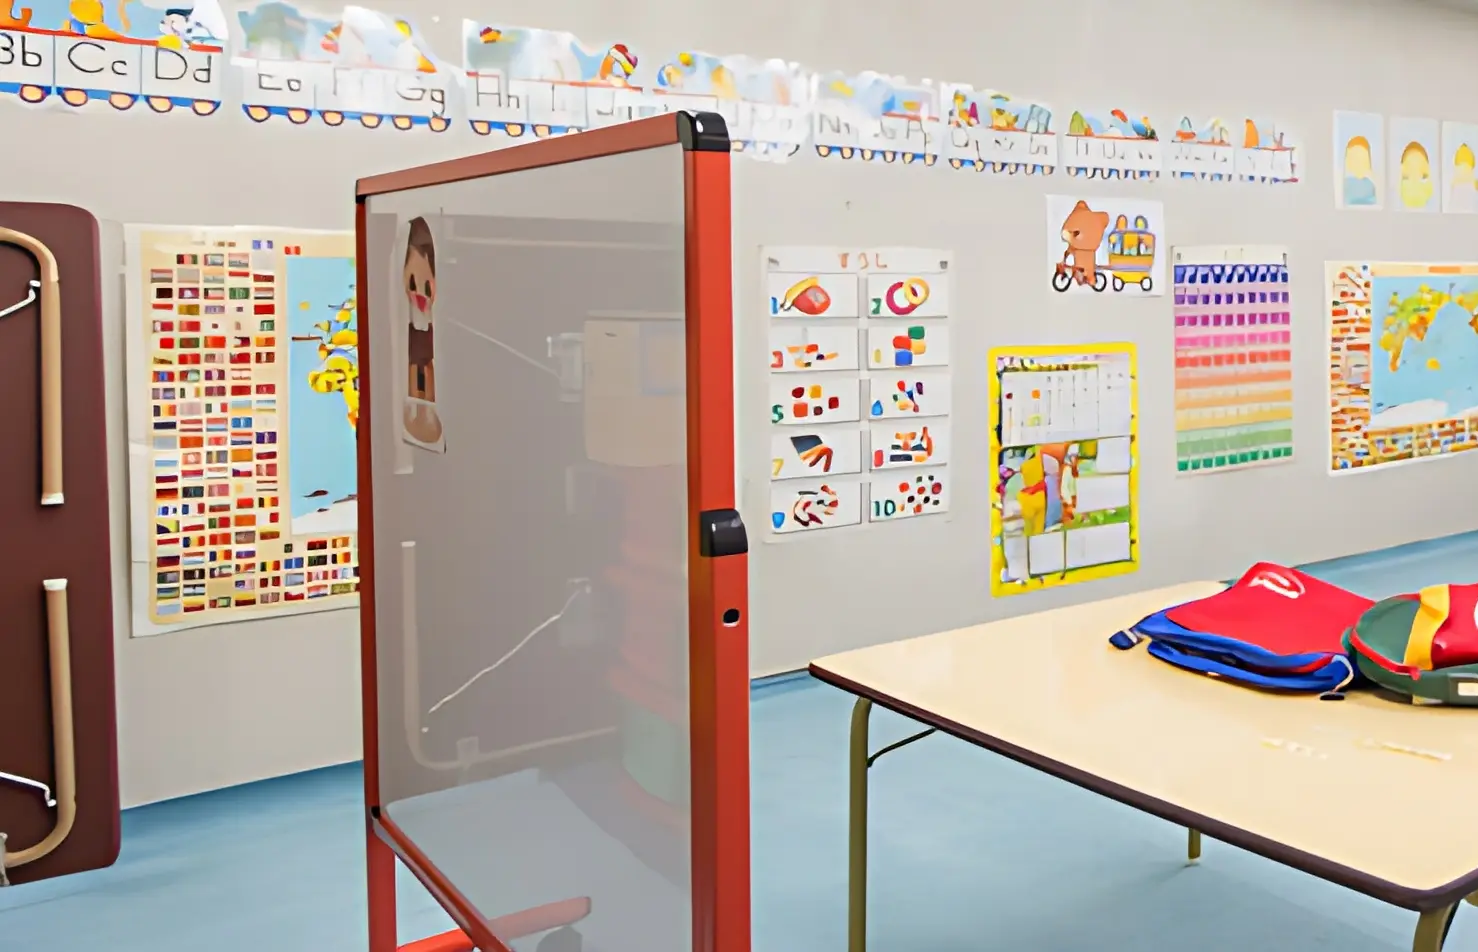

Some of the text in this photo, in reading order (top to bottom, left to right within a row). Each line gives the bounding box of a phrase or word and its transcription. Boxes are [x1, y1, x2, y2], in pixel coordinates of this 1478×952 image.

[67, 41, 128, 76] Cc
[155, 46, 213, 83] Dd
[874, 498, 897, 517] 10
